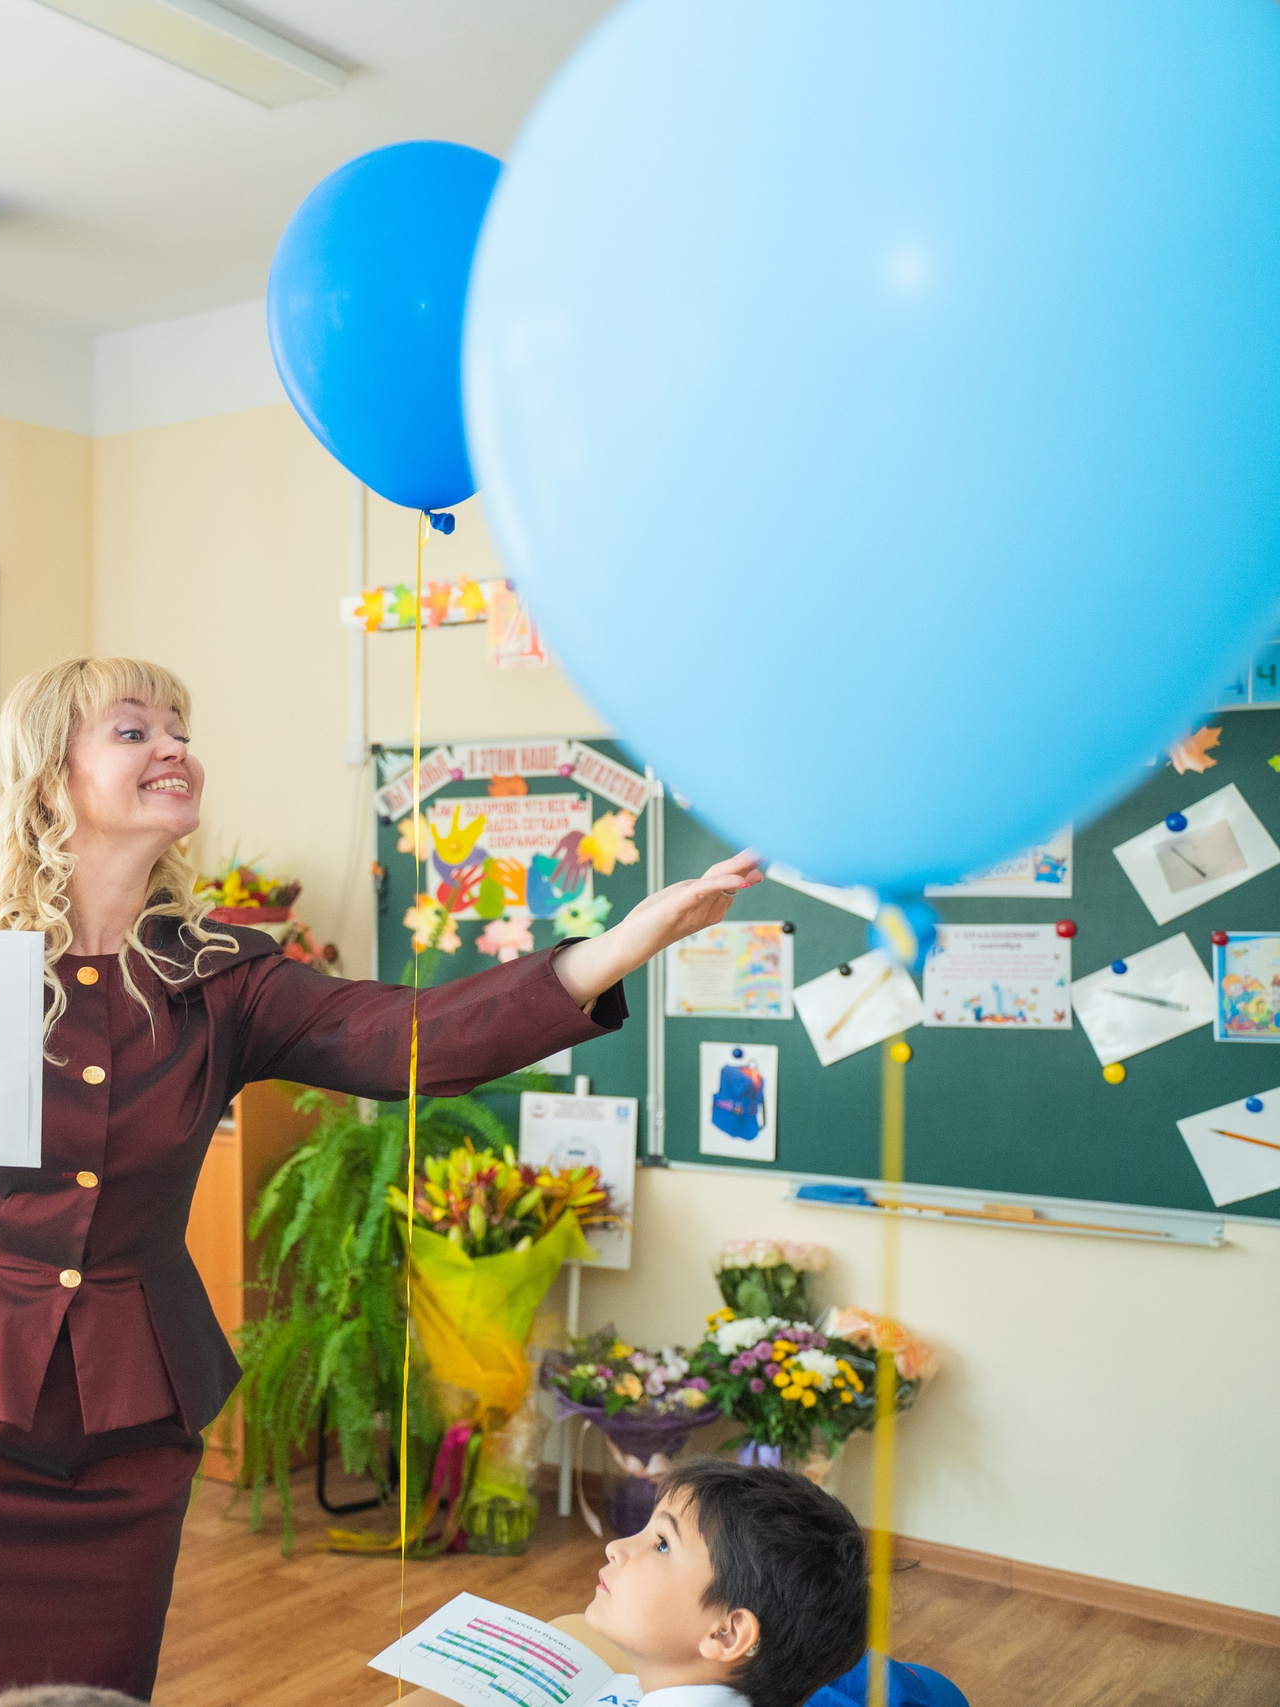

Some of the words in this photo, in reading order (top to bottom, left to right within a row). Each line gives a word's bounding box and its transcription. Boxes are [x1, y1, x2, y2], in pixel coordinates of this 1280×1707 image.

[480, 748, 517, 773] ЭТОМ
[521, 746, 559, 771] НАШЕ
[573, 751, 647, 808] БОГАТСТВО
